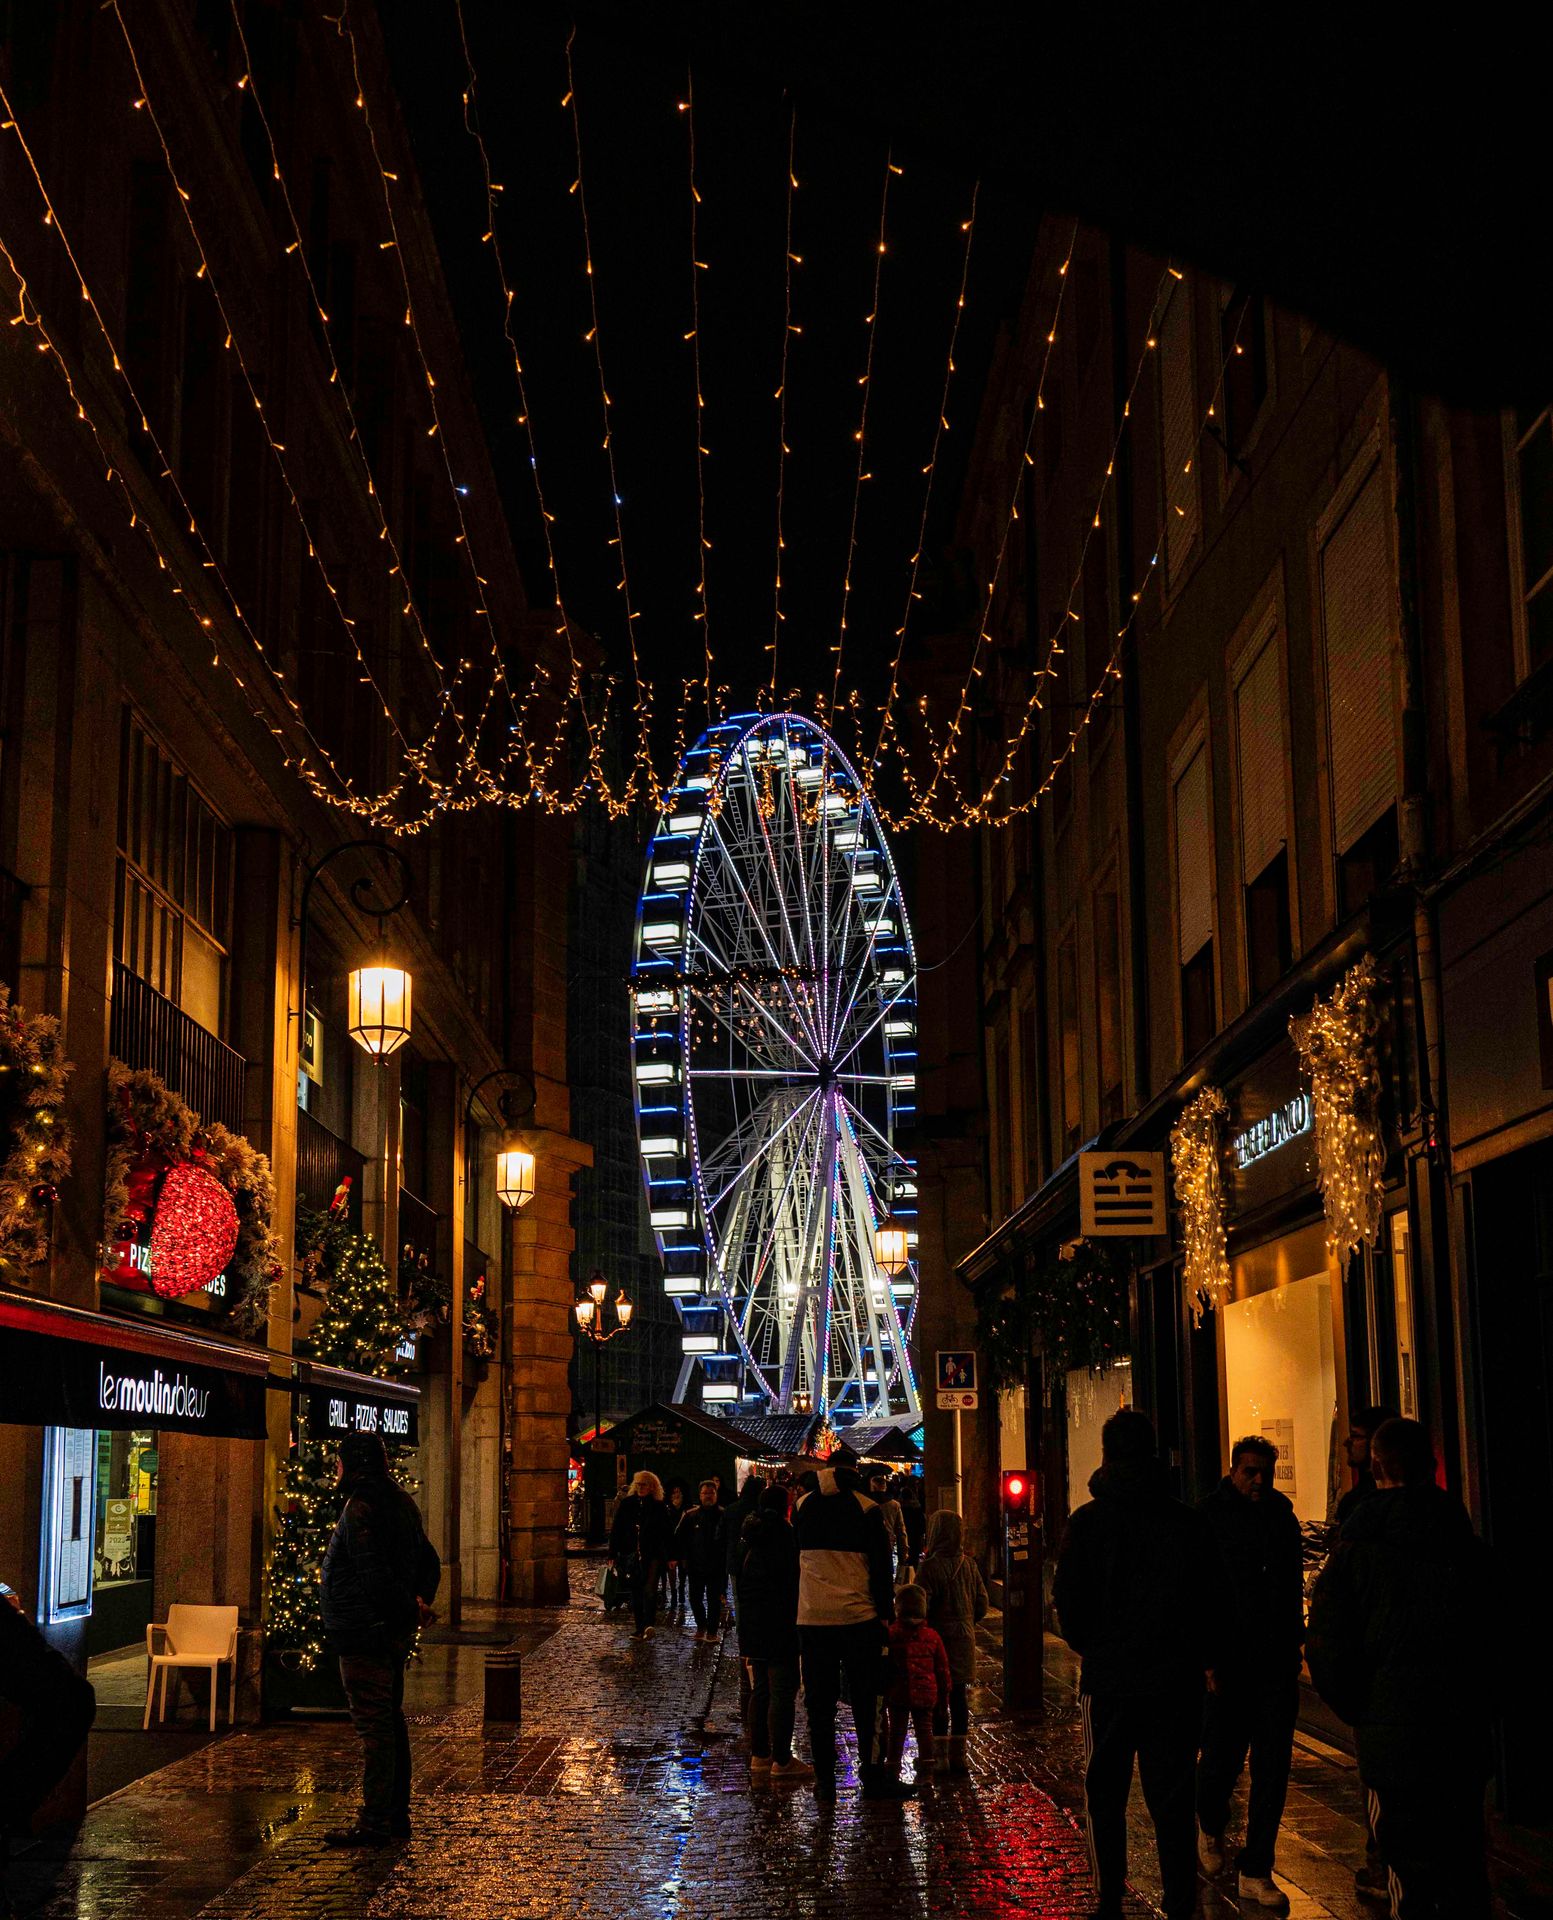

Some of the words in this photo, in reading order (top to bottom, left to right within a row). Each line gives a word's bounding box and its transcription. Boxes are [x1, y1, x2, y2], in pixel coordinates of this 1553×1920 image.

[328, 1399, 349, 1428] GRILL
[355, 1404, 378, 1432] PIZZAS
[383, 1408, 409, 1435] SALADES
